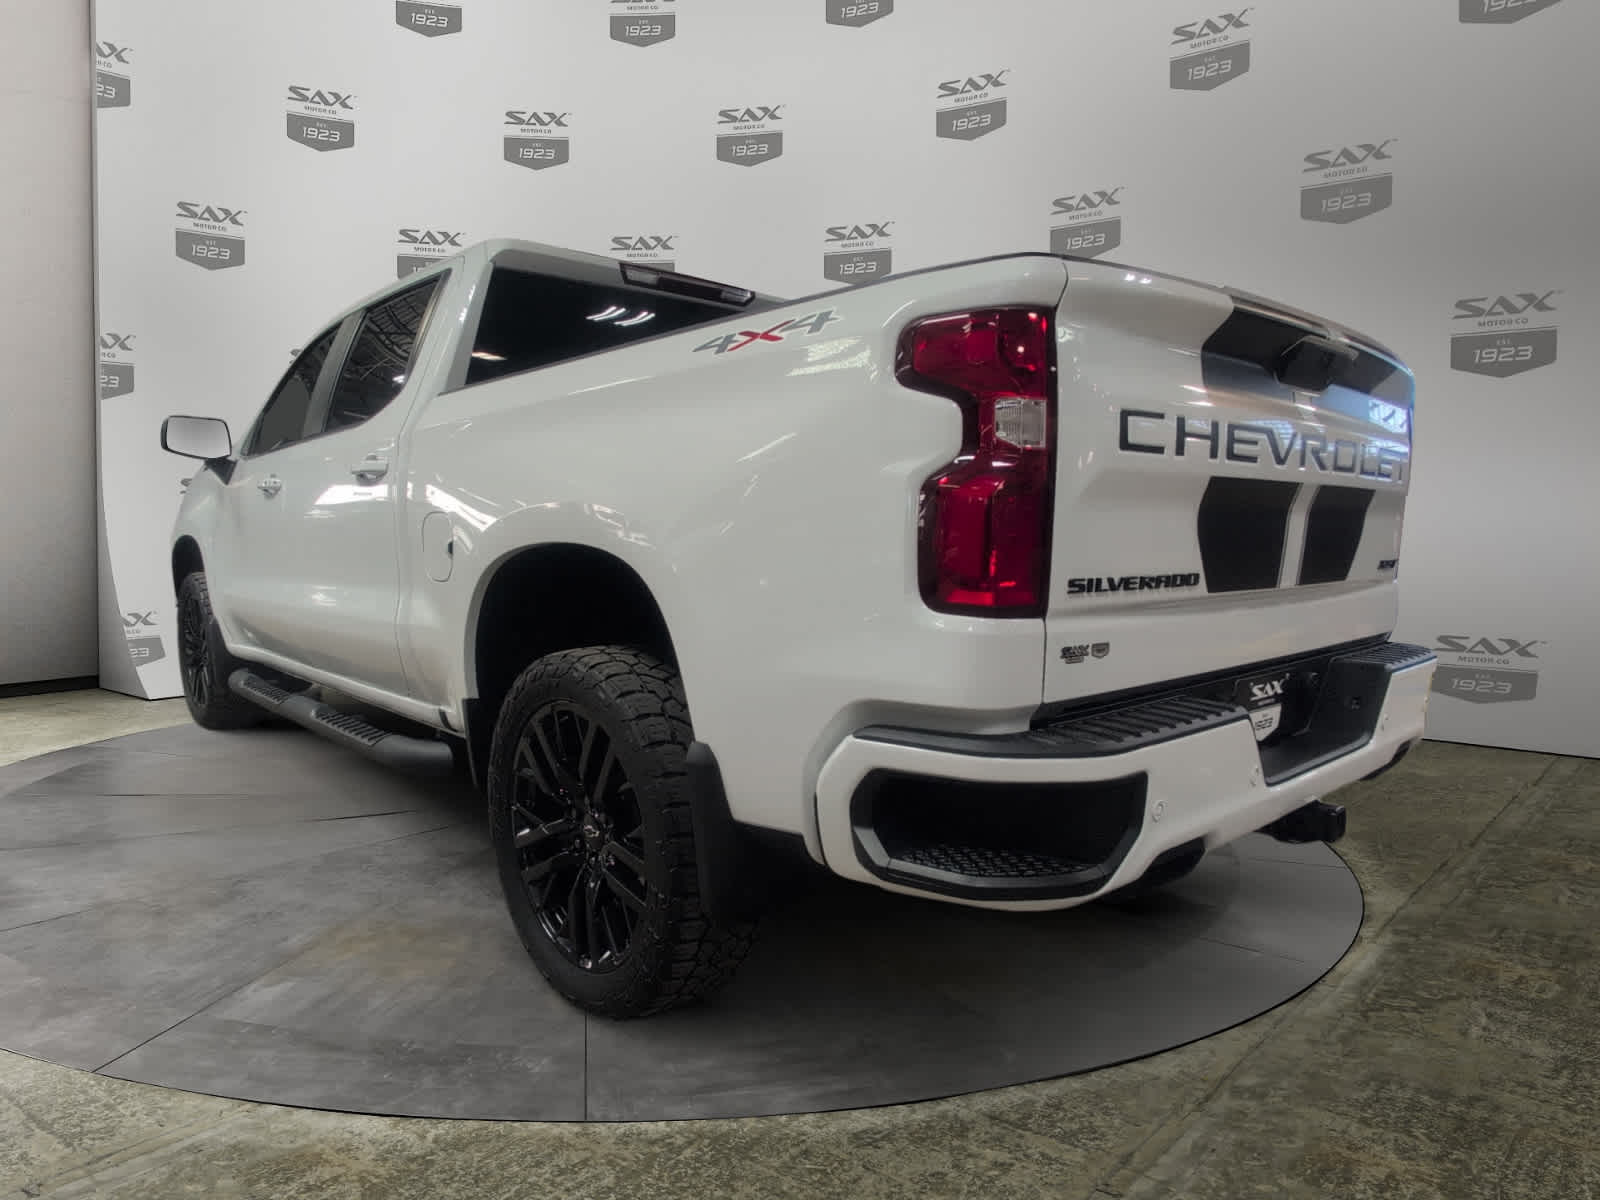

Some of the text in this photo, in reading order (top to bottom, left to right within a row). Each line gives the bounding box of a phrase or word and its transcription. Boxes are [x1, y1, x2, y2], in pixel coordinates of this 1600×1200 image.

[841, 2, 879, 18] 1923
[411, 12, 448, 28] 1923
[1169, 8, 1249, 46] SAX
[624, 25, 662, 37] 1923
[96, 41, 130, 65] AX
[1187, 59, 1232, 81] 1923
[96, 83, 116, 98] 23
[936, 69, 1007, 99] SAX
[287, 85, 353, 110] SAX
[504, 111, 569, 127] SAX
[717, 104, 783, 124] SAX
[951, 114, 992, 132] 1923
[302, 127, 340, 142] 1923
[519, 148, 555, 160] 1923
[731, 143, 769, 157] 1923
[1302, 138, 1392, 174] SAX
[1050, 186, 1121, 215] SAX
[1320, 192, 1373, 212] 1923
[175, 201, 244, 226] SAX
[398, 229, 462, 247] SAX
[824, 221, 892, 242] SAX
[609, 235, 674, 251] SAX
[1065, 233, 1106, 250] 1923
[192, 244, 230, 260] 1923
[839, 261, 878, 275] 1923
[1452, 290, 1557, 320] SAX
[100, 332, 133, 351] AX
[1473, 345, 1534, 364] 1923
[100, 375, 120, 388] 23
[1066, 572, 1200, 595] SILVERADO
[121, 610, 158, 628] AX
[129, 647, 150, 657] 23
[1433, 635, 1539, 659] SAX
[1250, 679, 1286, 701] SAX
[1451, 677, 1513, 694] 1923
